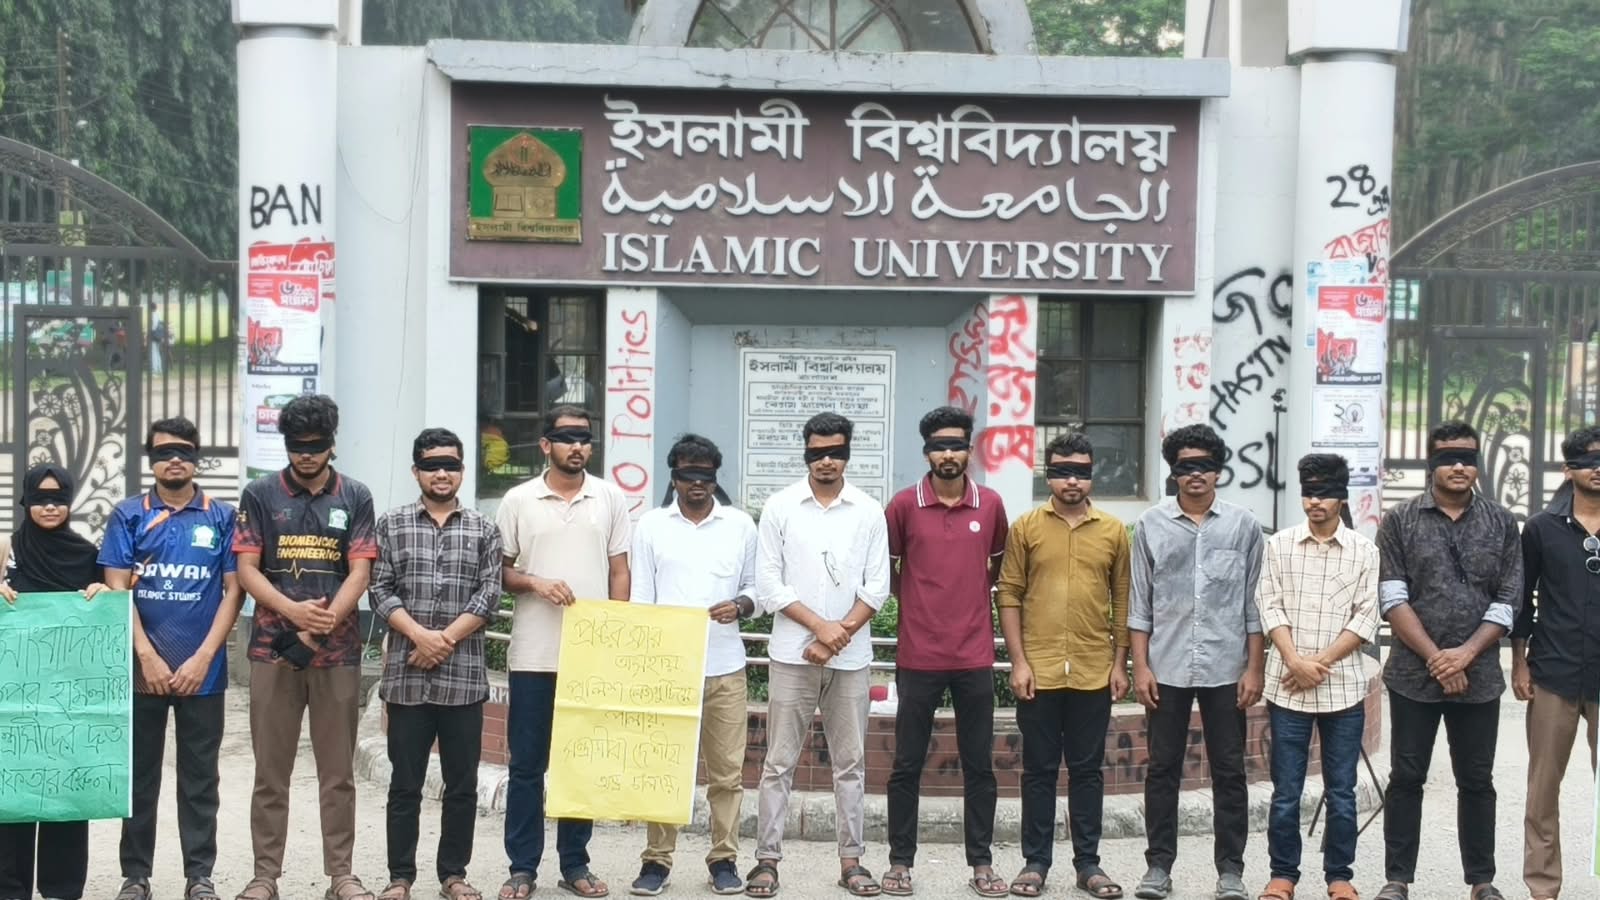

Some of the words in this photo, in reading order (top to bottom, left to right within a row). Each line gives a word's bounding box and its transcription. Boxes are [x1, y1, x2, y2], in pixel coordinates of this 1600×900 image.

[603, 93, 811, 161] ইসলামী
[844, 102, 1177, 173] বিশ্ববিদ্যালয়
[911, 164, 1171, 235] الجامعة
[1326, 164, 1376, 208] 28
[250, 183, 323, 230] BAN
[602, 232, 821, 277] ISLAMIC
[851, 237, 1173, 283] UNIVERSITY
[749, 359, 798, 373] ইসলামী
[803, 360, 887, 376] বিশ্ববিদ্যালয়
[276, 547, 343, 561] ENGINEERING
[278, 534, 340, 549] BIOMEDICAL
[162, 579, 174, 591] &
[0, 681, 42, 717] পর
